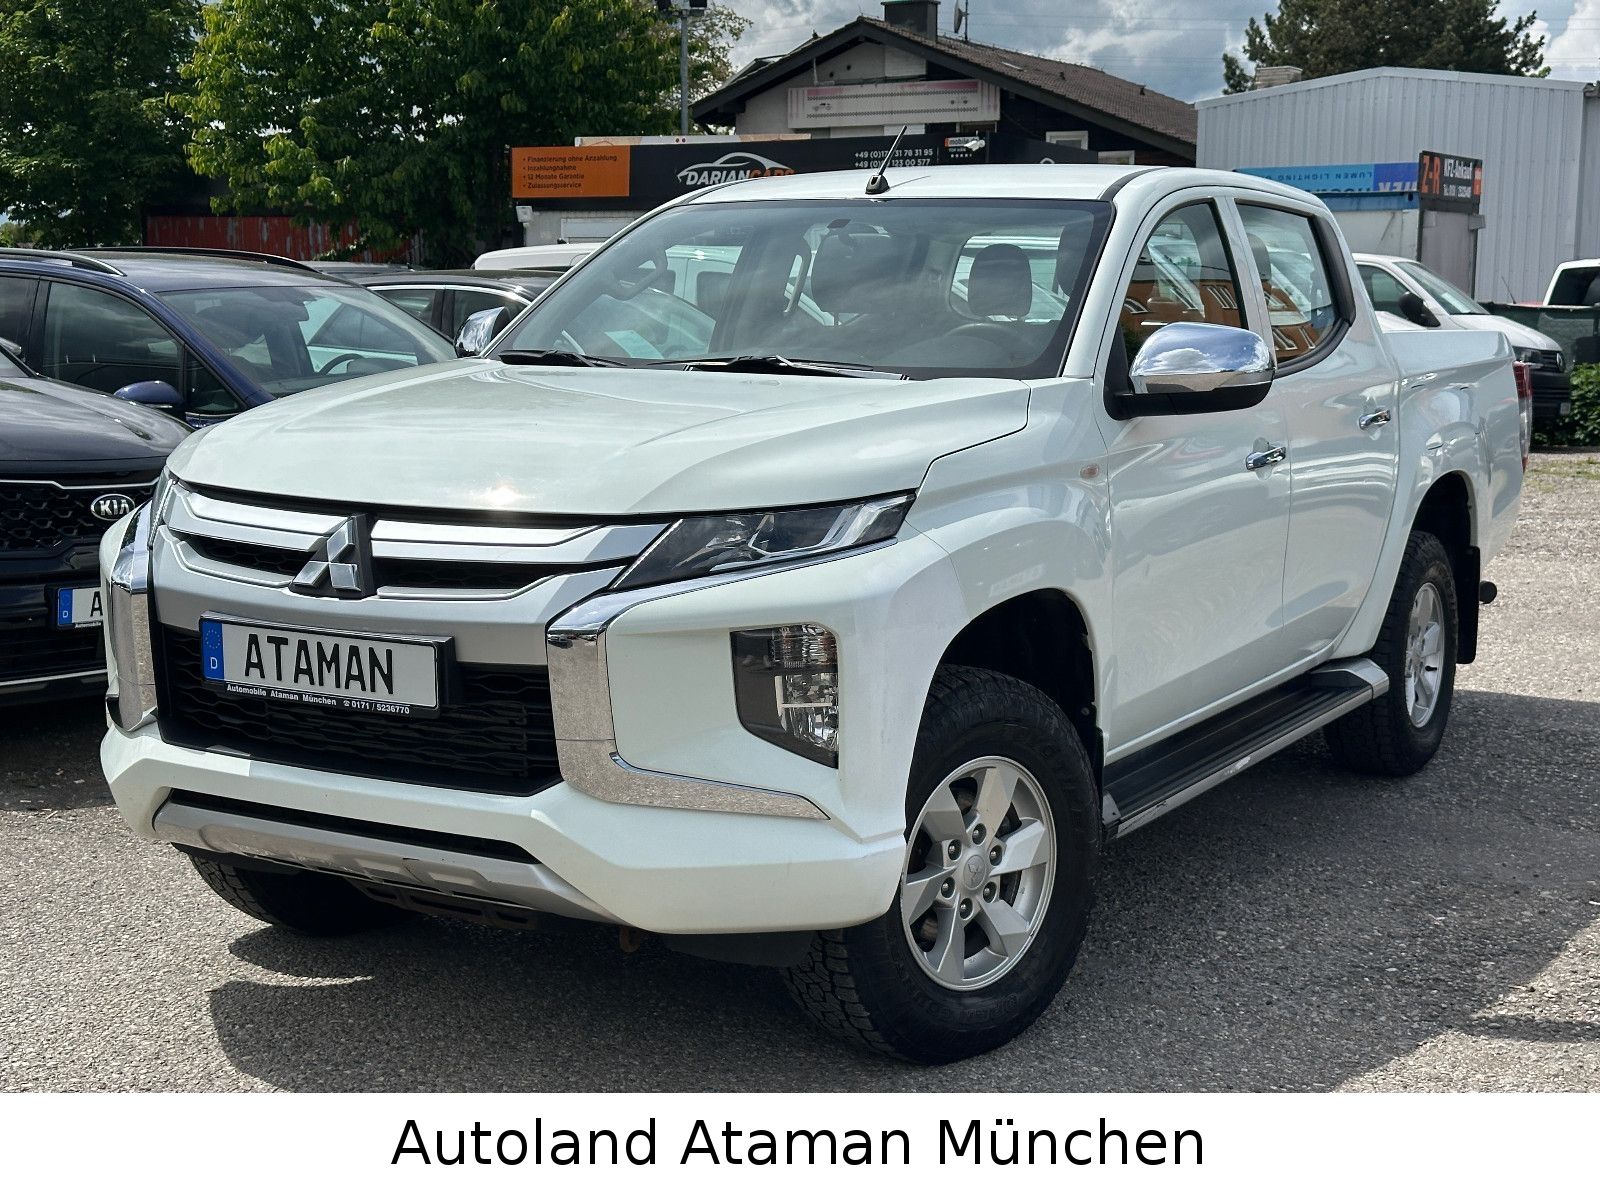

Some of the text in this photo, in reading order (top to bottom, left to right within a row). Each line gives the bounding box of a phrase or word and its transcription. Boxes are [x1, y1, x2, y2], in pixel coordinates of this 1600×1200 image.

[854, 151, 868, 159] +49
[895, 149, 903, 157] 31
[904, 149, 913, 157] 78
[914, 148, 922, 157] 31
[923, 148, 934, 156] 95
[527, 156, 566, 164] Finanzierung
[584, 154, 618, 162] Anzahlung
[854, 160, 868, 168] +49
[891, 159, 903, 167] 123
[905, 158, 915, 166] 00
[917, 158, 931, 166] 577
[527, 164, 577, 172] Inzahlungnahme
[527, 182, 582, 190] Zulassungsservice
[99, 499, 130, 516] KIA
[62, 610, 69, 618] D
[210, 656, 218, 670] D
[244, 633, 394, 695] ATAMAN
[226, 684, 267, 697] Automobile
[270, 690, 299, 701] Ataman
[302, 693, 337, 706] München
[351, 700, 370, 710] 0171
[376, 703, 410, 714] 5236770
